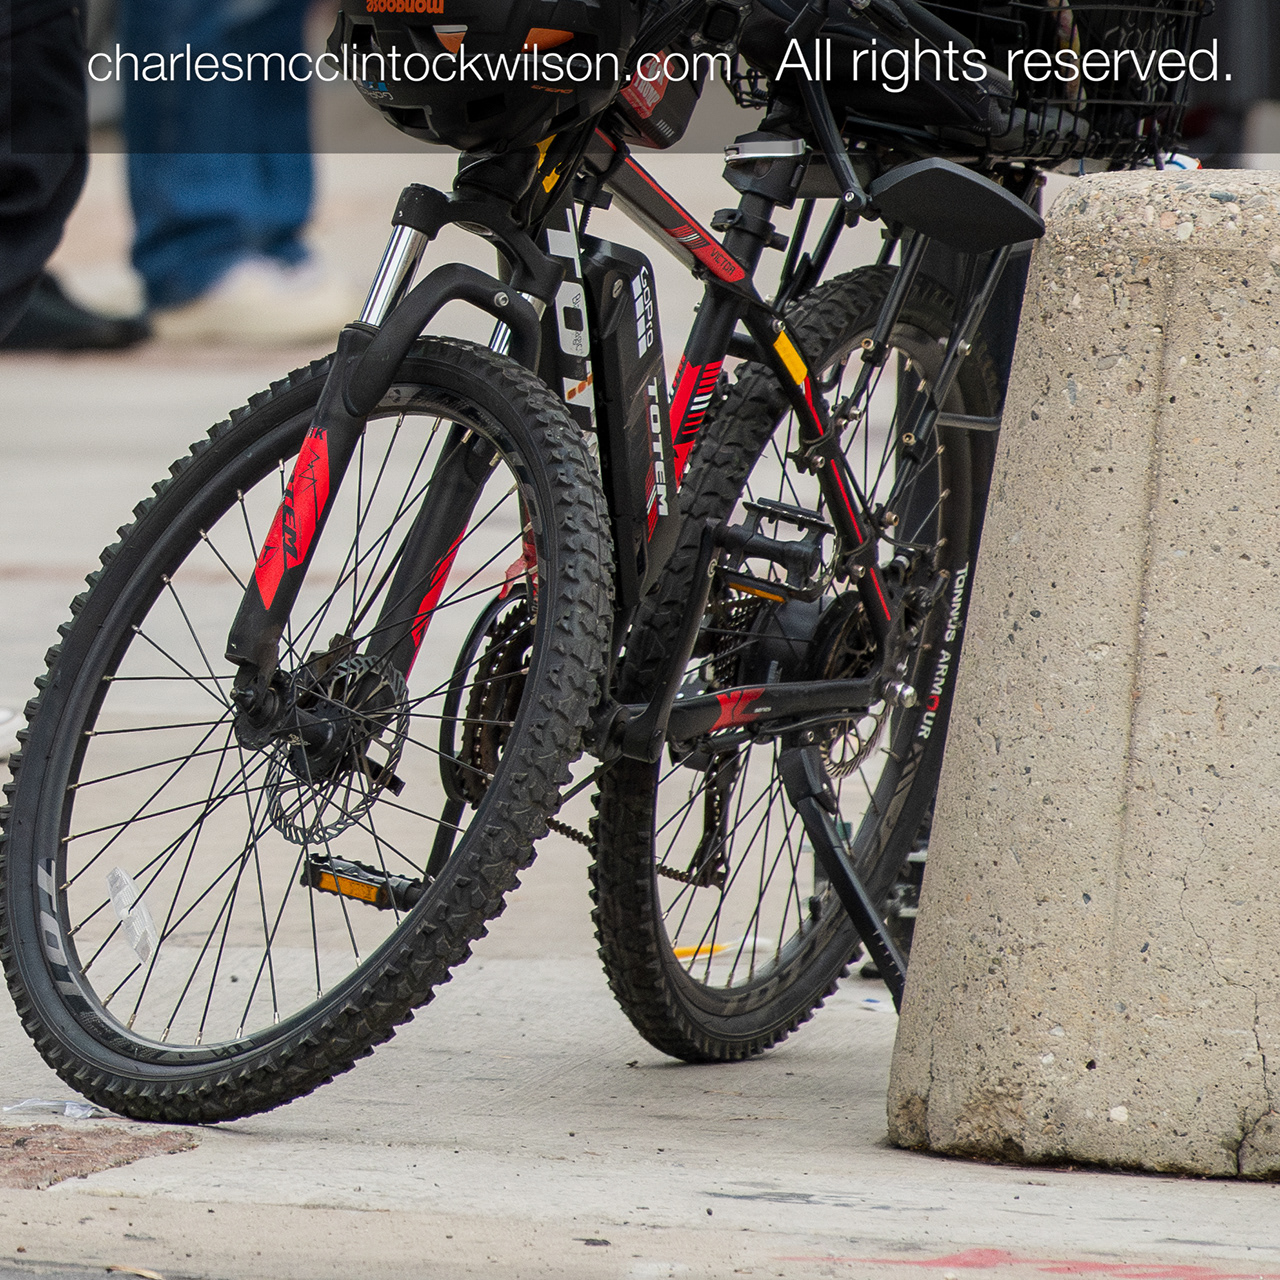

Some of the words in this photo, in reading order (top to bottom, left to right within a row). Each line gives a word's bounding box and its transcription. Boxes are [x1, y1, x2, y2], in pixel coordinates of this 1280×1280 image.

[640, 265, 655, 348] GoPro
[646, 376, 669, 516] TOTEM
[917, 649, 952, 740] ARMOUR
